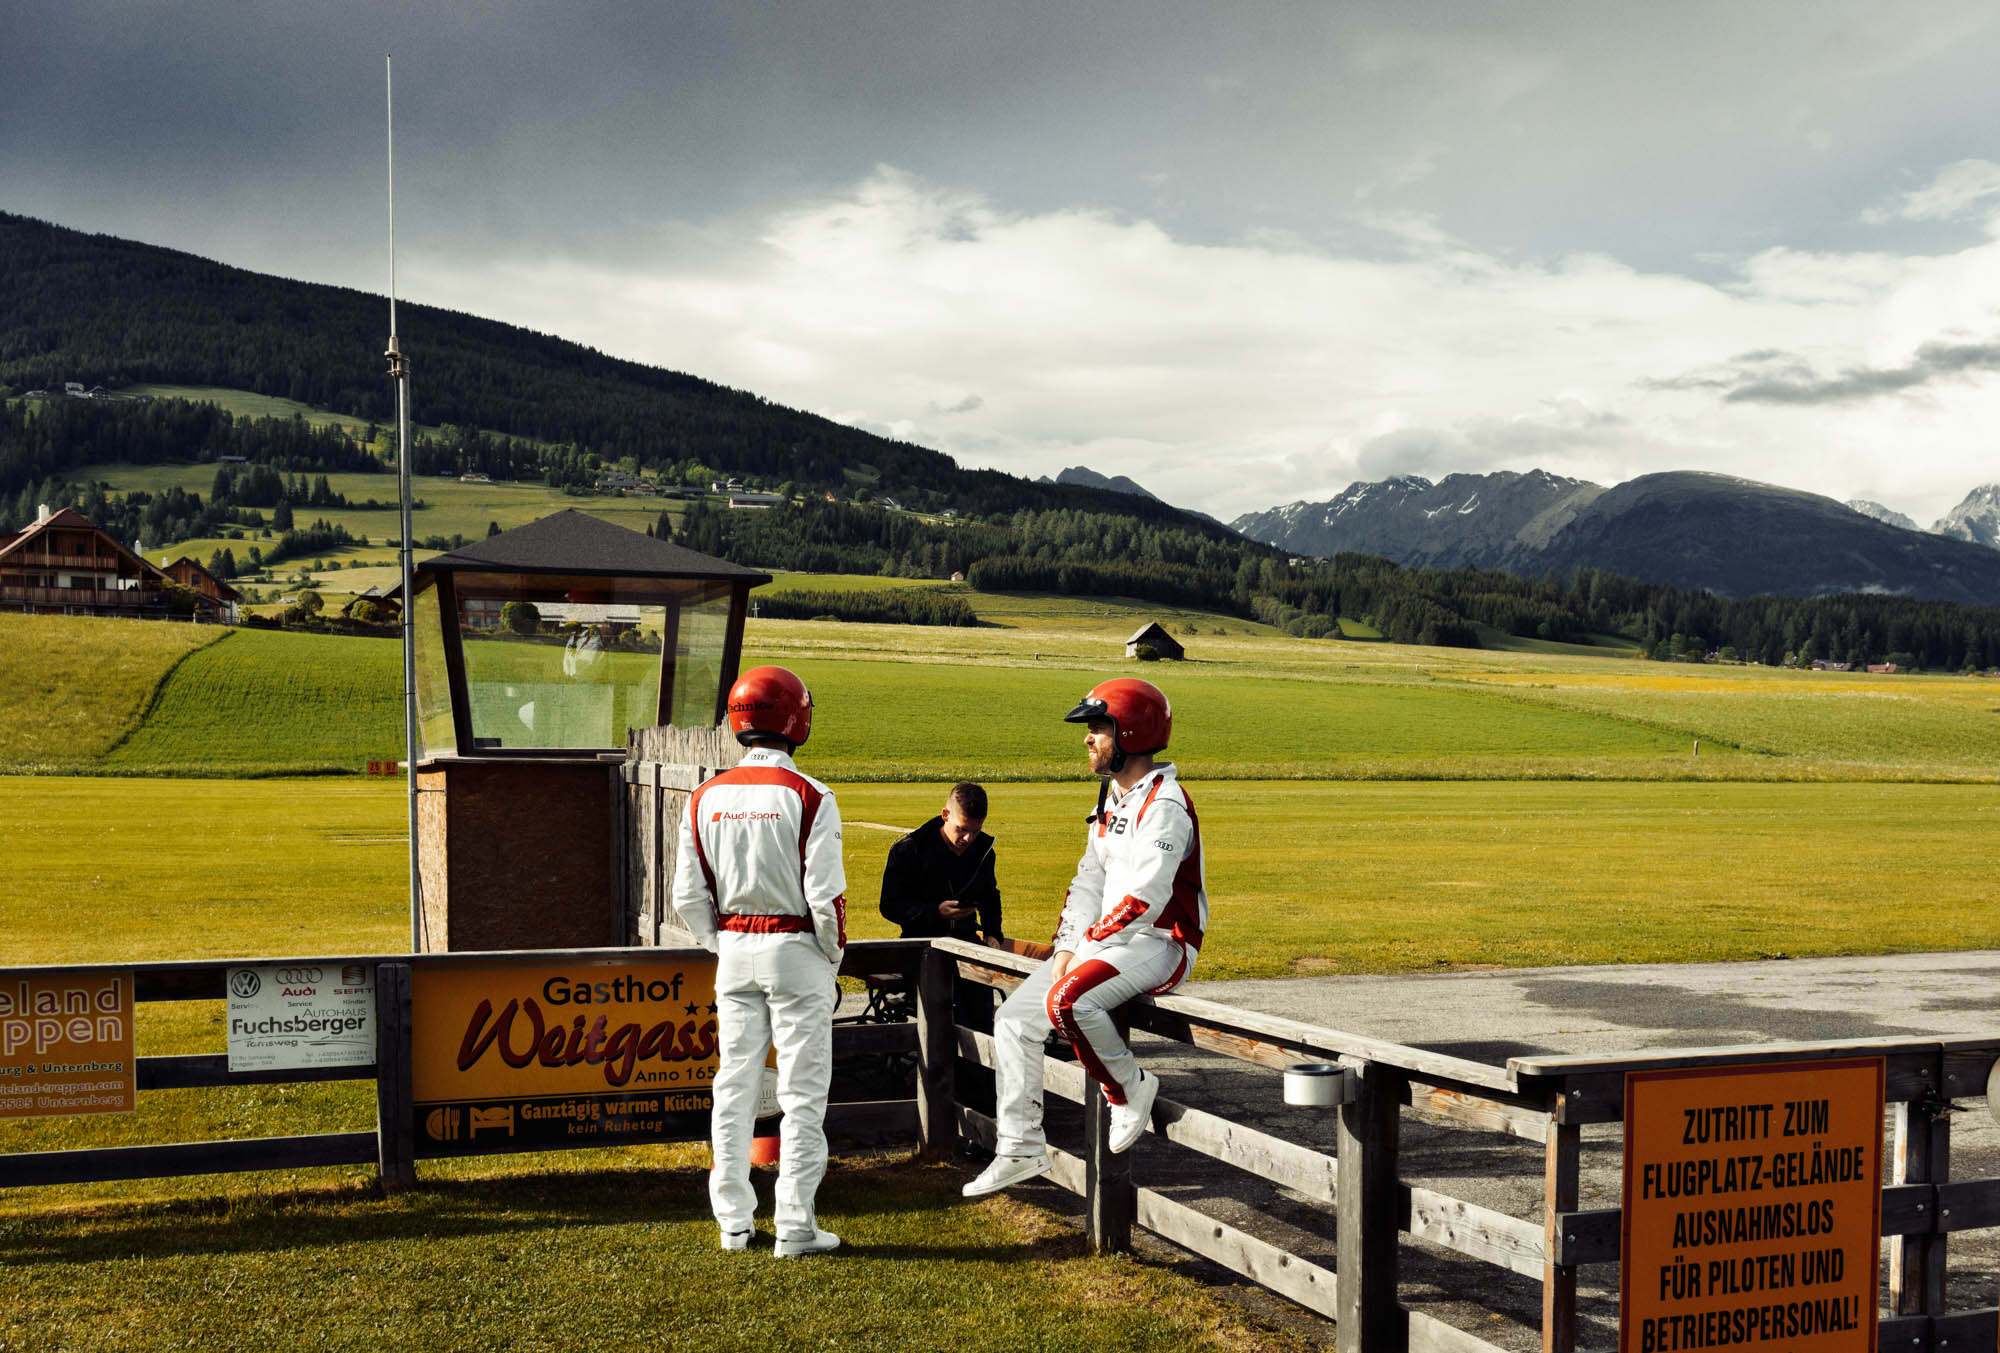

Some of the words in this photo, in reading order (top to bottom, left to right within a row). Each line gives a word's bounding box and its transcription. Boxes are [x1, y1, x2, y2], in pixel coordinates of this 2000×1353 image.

[723, 811, 747, 820] Audi
[750, 811, 781, 821] Sport
[1107, 816, 1129, 835] R8
[282, 987, 317, 997] Audi
[333, 987, 374, 995] SEAT
[543, 972, 683, 1006] Gasthof
[1053, 975, 1080, 1003] Sport
[232, 1015, 366, 1036] Fuchsberger
[1051, 1005, 1065, 1029] Audi
[4, 1016, 122, 1056] ppen
[457, 997, 720, 1087] Weitgass
[27, 1064, 36, 1074] &
[42, 1061, 122, 1073] Unternberg
[634, 1070, 679, 1082] Anno
[39, 1095, 124, 1108] Unternberg
[520, 1101, 600, 1121] Ganztägig
[605, 1099, 658, 1116] warme
[664, 1093, 712, 1113] Küche
[568, 1122, 598, 1135] kein
[604, 1119, 663, 1134] Ruhetag
[1683, 1104, 1774, 1144] ZUTRITT
[1783, 1099, 1829, 1137] ZUM
[1643, 1141, 1865, 1200] FLUGPLATZ-GELÄNDE
[1672, 1199, 1835, 1249] AUSNAHMSLOS
[1660, 1255, 1701, 1301] FÜR
[1708, 1253, 1795, 1296] PILOTEN
[1801, 1248, 1844, 1286] UND
[1641, 1296, 1860, 1353] BETRIEBSPERSONAL!
